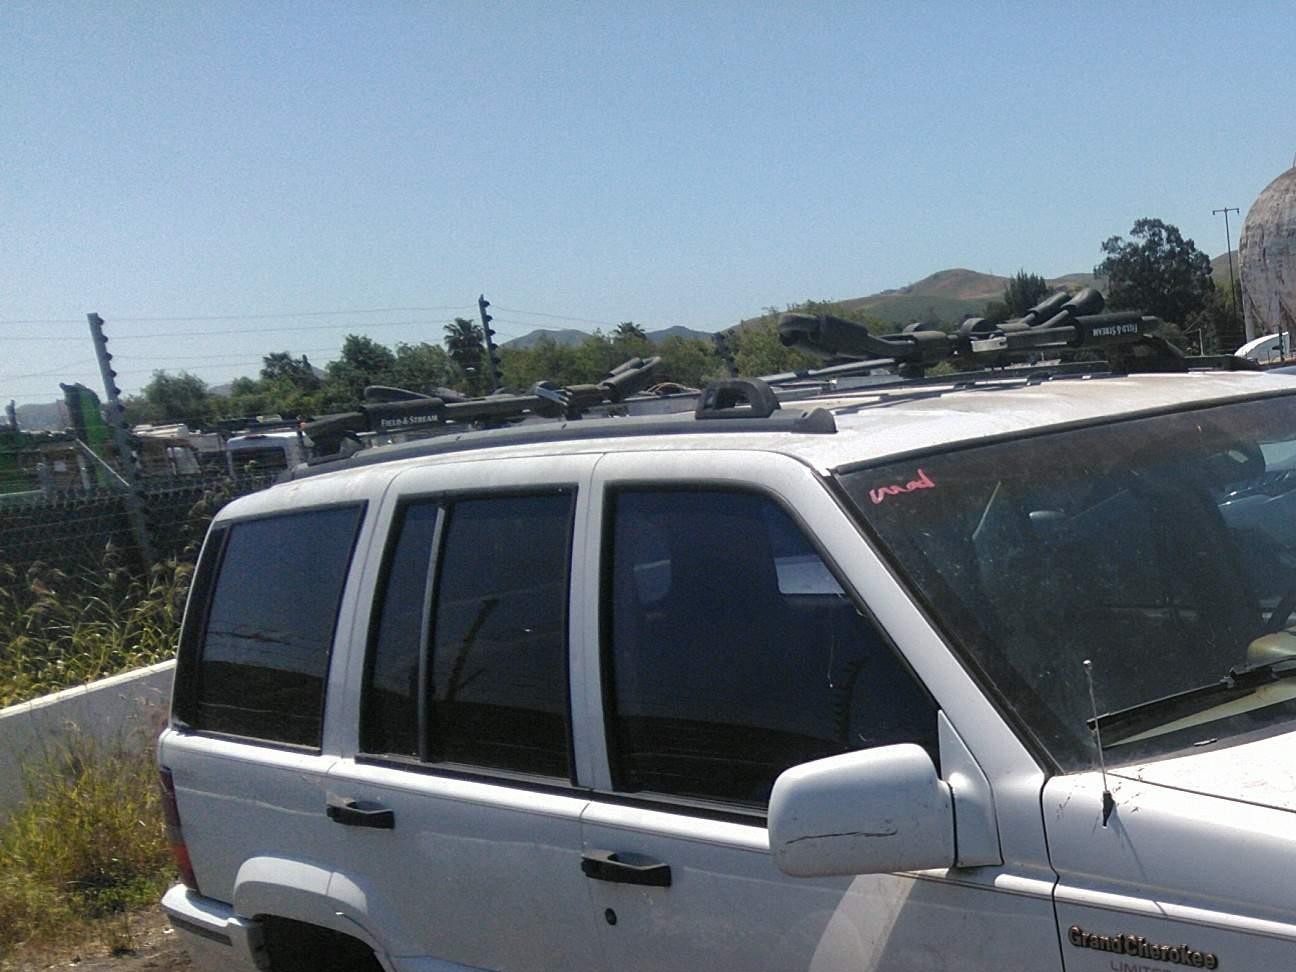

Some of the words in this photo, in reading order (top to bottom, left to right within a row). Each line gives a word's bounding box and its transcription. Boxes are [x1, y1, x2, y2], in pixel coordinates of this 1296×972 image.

[381, 419, 401, 427] FIELD
[409, 415, 438, 424] STREAM
[1068, 925, 1124, 954] Grand
[1124, 932, 1218, 970] Cherokee
